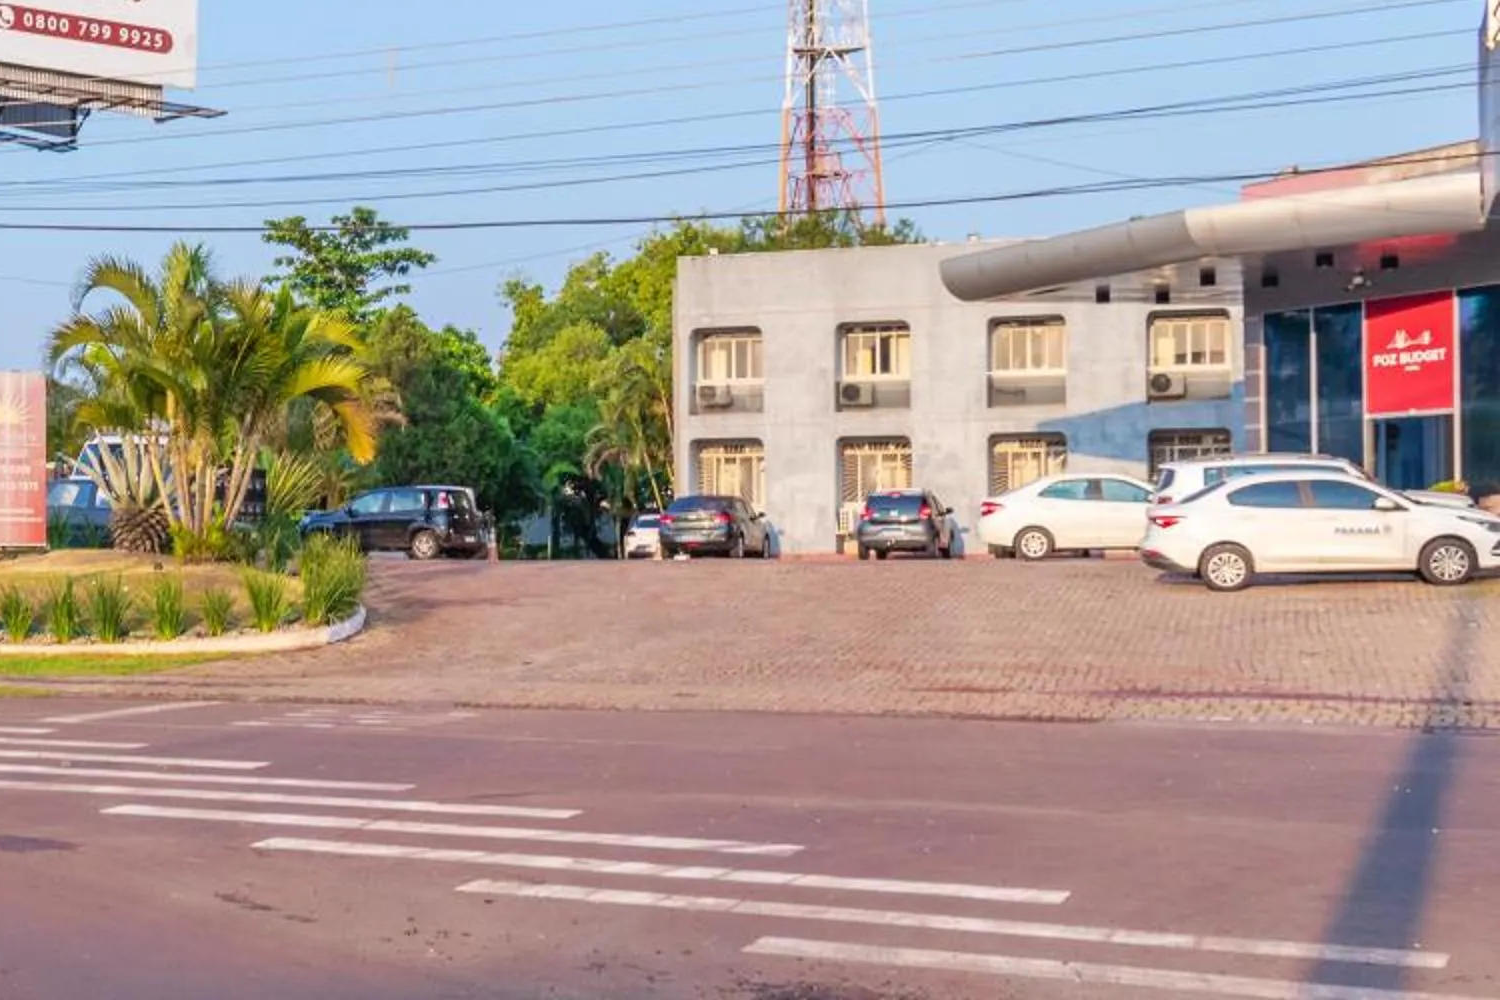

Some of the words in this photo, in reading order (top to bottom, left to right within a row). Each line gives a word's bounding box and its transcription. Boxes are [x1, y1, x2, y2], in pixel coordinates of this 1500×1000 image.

[23, 11, 69, 33] 0800
[78, 21, 112, 40] 799
[119, 29, 163, 49] 9925
